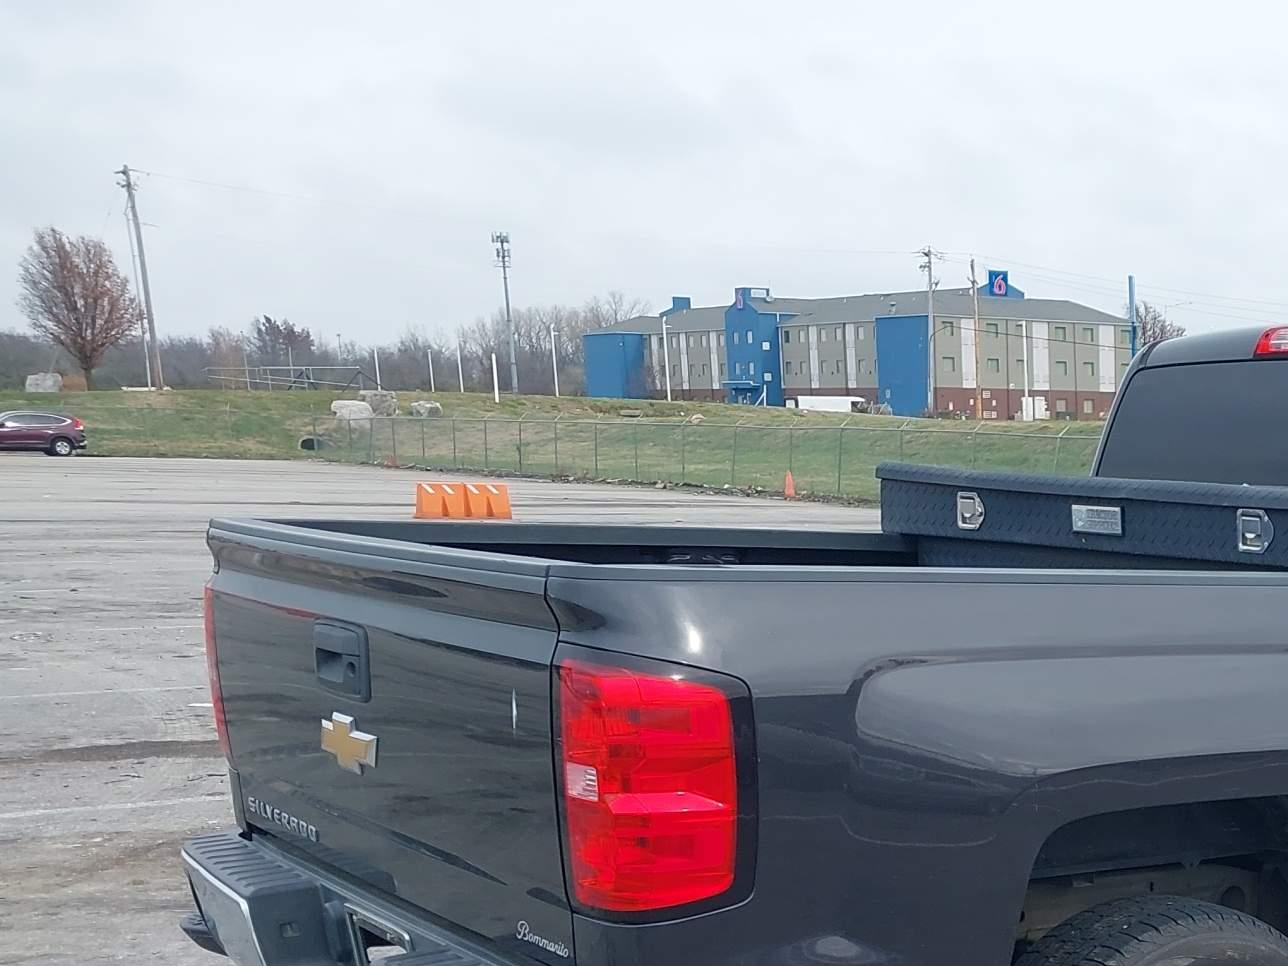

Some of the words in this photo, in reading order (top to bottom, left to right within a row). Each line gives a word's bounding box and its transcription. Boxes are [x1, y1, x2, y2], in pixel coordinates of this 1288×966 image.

[994, 275, 1006, 295] 6
[247, 796, 318, 842] SILVERADO
[515, 920, 569, 958] Bommarito
